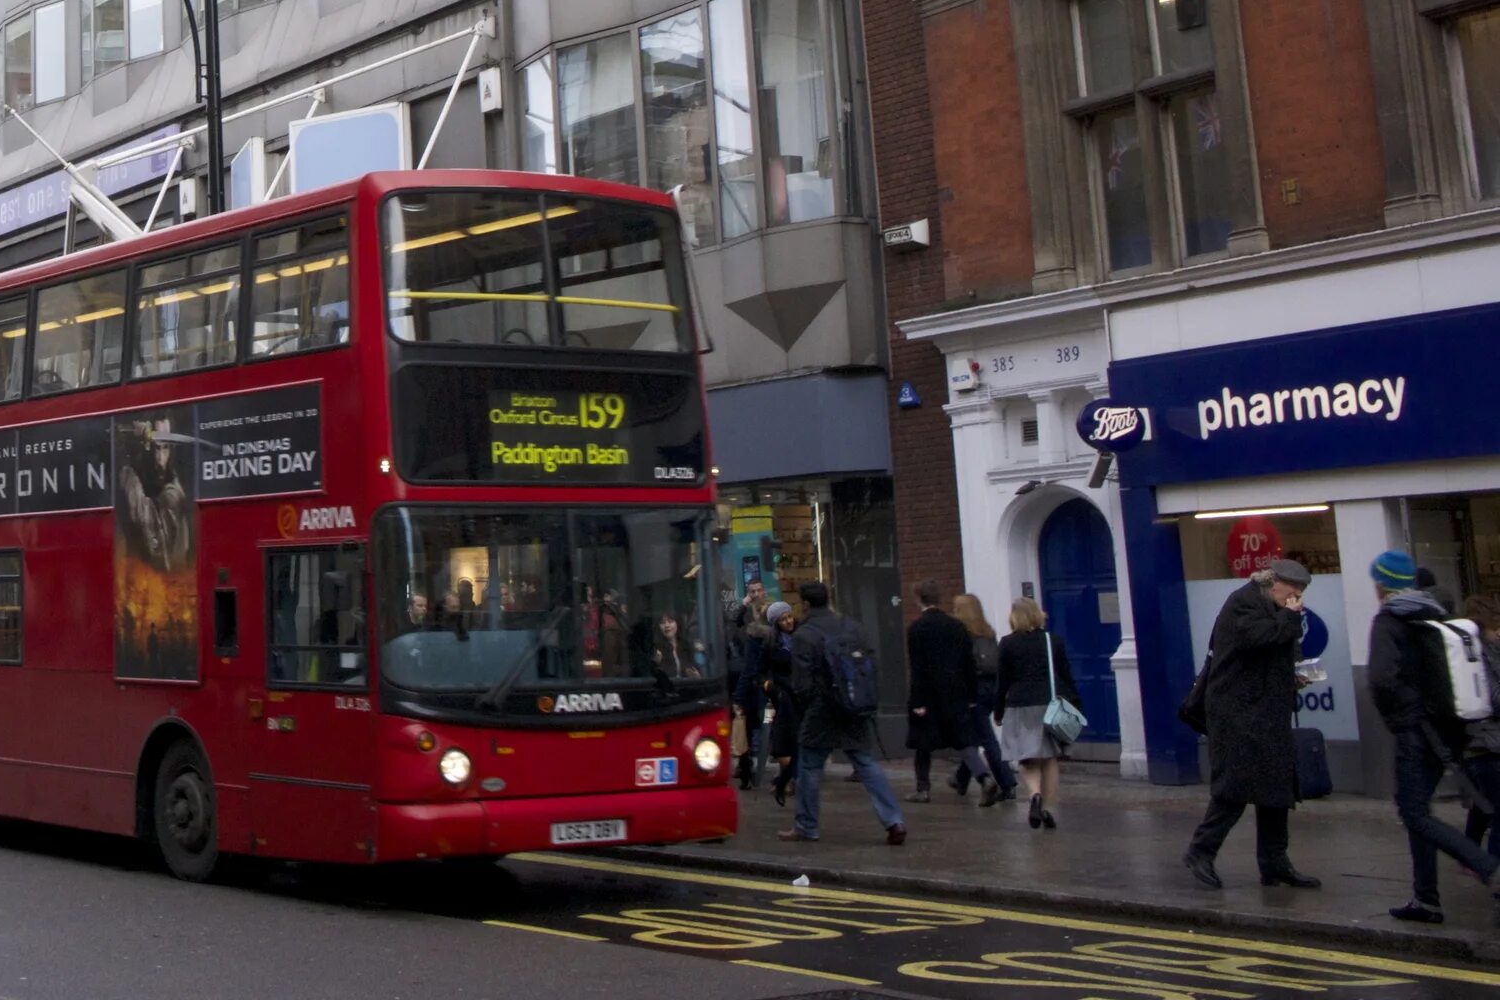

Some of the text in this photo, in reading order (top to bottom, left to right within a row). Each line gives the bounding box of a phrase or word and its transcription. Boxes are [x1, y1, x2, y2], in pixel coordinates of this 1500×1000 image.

[28, 186, 53, 214] one
[992, 355, 1015, 373] 385
[1056, 345, 1080, 364] 389
[245, 415, 260, 424] THE
[490, 409, 579, 425] Oxford Circus
[579, 395, 625, 428] 159
[1198, 376, 1405, 441] pharmacy
[1089, 406, 1139, 440] Boots
[25, 439, 73, 455] REEVES
[222, 438, 292, 457] IN CINEMAS
[491, 442, 629, 473] Paddington Basin
[202, 451, 316, 480] BOXING DAY
[300, 506, 356, 530] ARRIVA
[1234, 554, 1252, 571] off
[554, 693, 624, 713] ARRIVA
